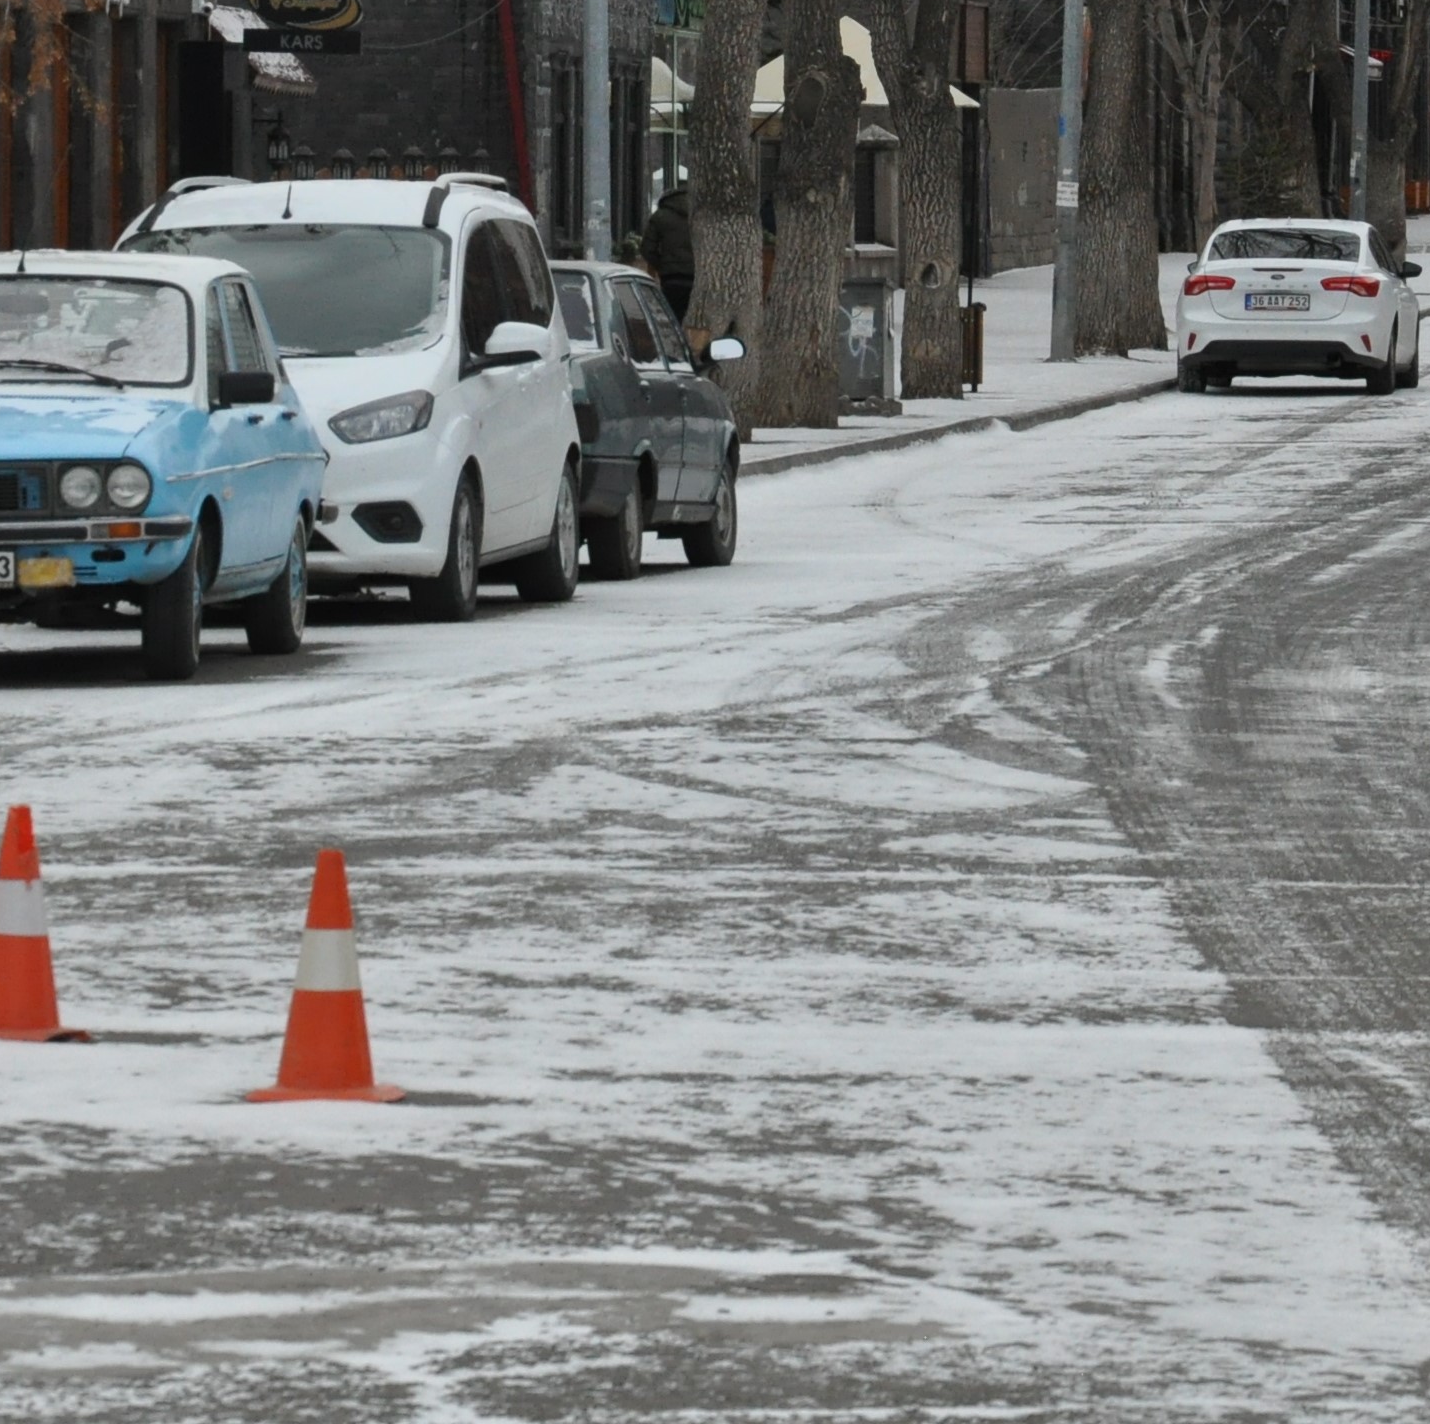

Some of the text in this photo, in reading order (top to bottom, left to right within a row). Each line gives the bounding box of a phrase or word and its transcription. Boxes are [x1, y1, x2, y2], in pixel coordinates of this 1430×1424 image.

[279, 34, 323, 50] KARS
[1252, 296, 1308, 307] 36 AAT 252
